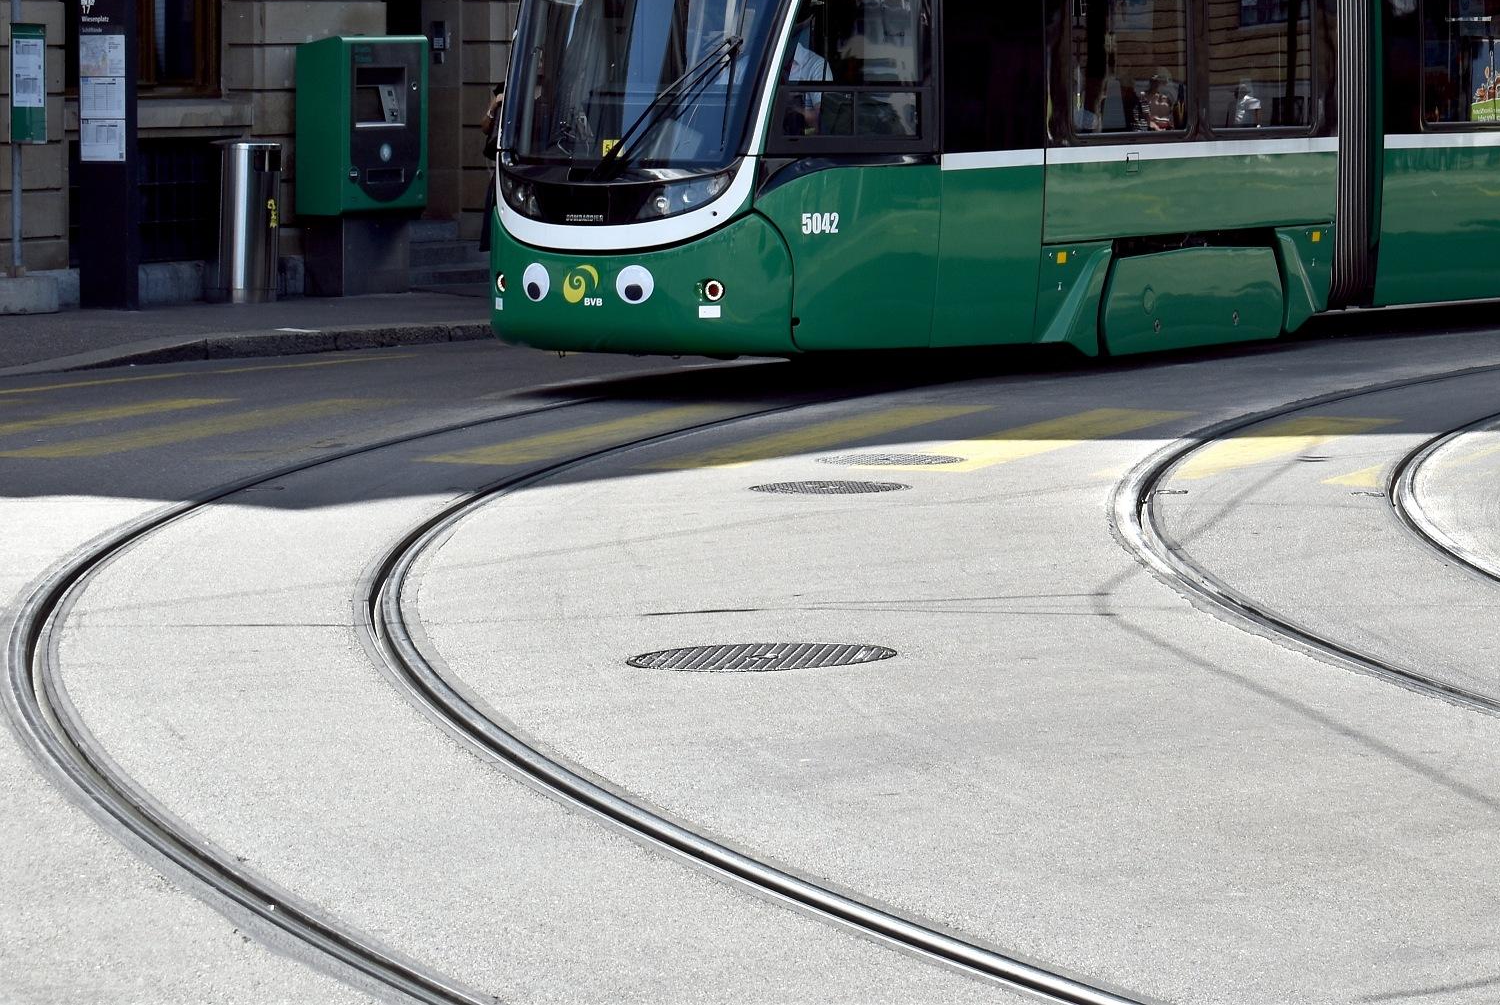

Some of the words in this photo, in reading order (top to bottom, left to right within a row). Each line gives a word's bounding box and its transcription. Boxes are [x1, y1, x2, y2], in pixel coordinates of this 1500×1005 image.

[82, 5, 91, 14] 17
[81, 16, 110, 24] Wiesenplatz
[802, 212, 840, 235] 5042
[584, 298, 603, 307] BVB
